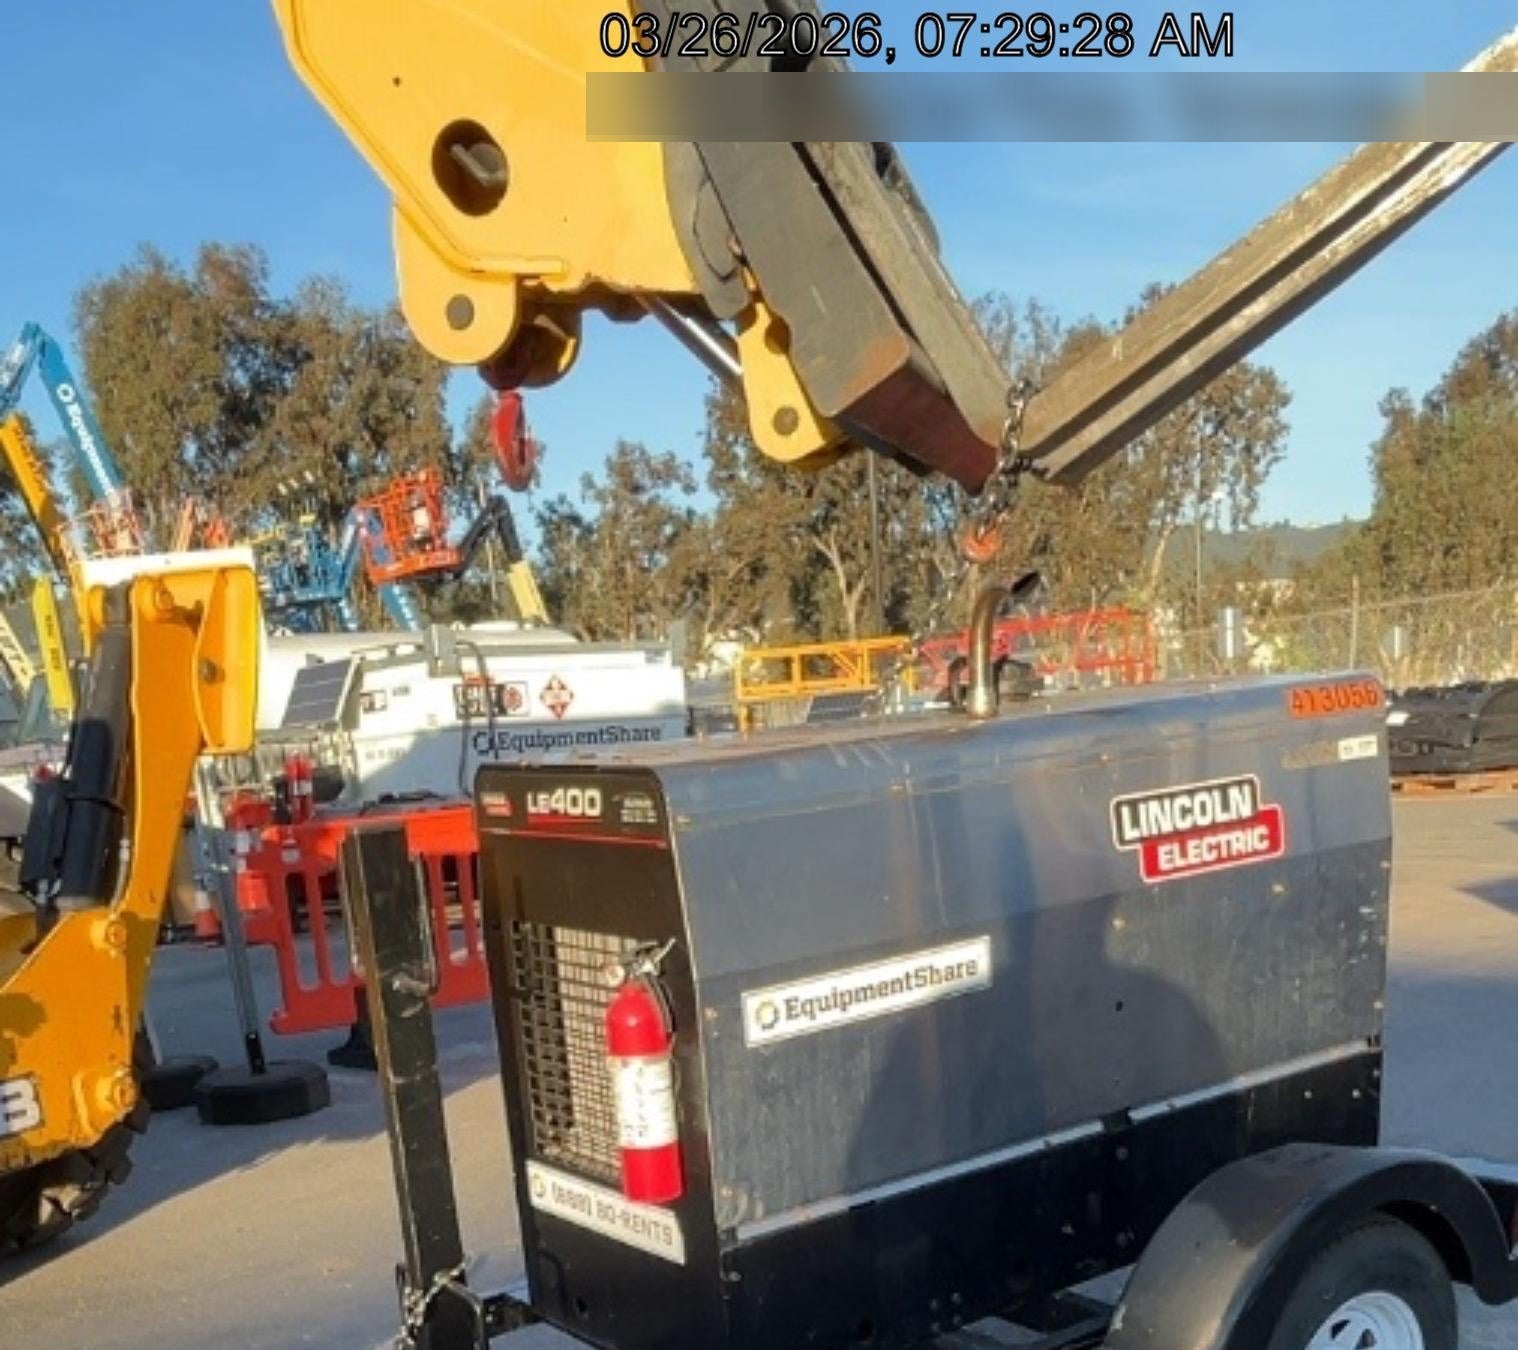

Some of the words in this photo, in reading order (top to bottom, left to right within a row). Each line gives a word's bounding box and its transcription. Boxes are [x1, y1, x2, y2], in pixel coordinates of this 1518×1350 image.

[498, 724, 662, 753] EquipmentShare
[527, 787, 602, 816] LE400
[1121, 783, 1252, 841] LINCOLN
[1157, 825, 1270, 871] ELECTRIC
[784, 959, 978, 1021] EquipmentShare
